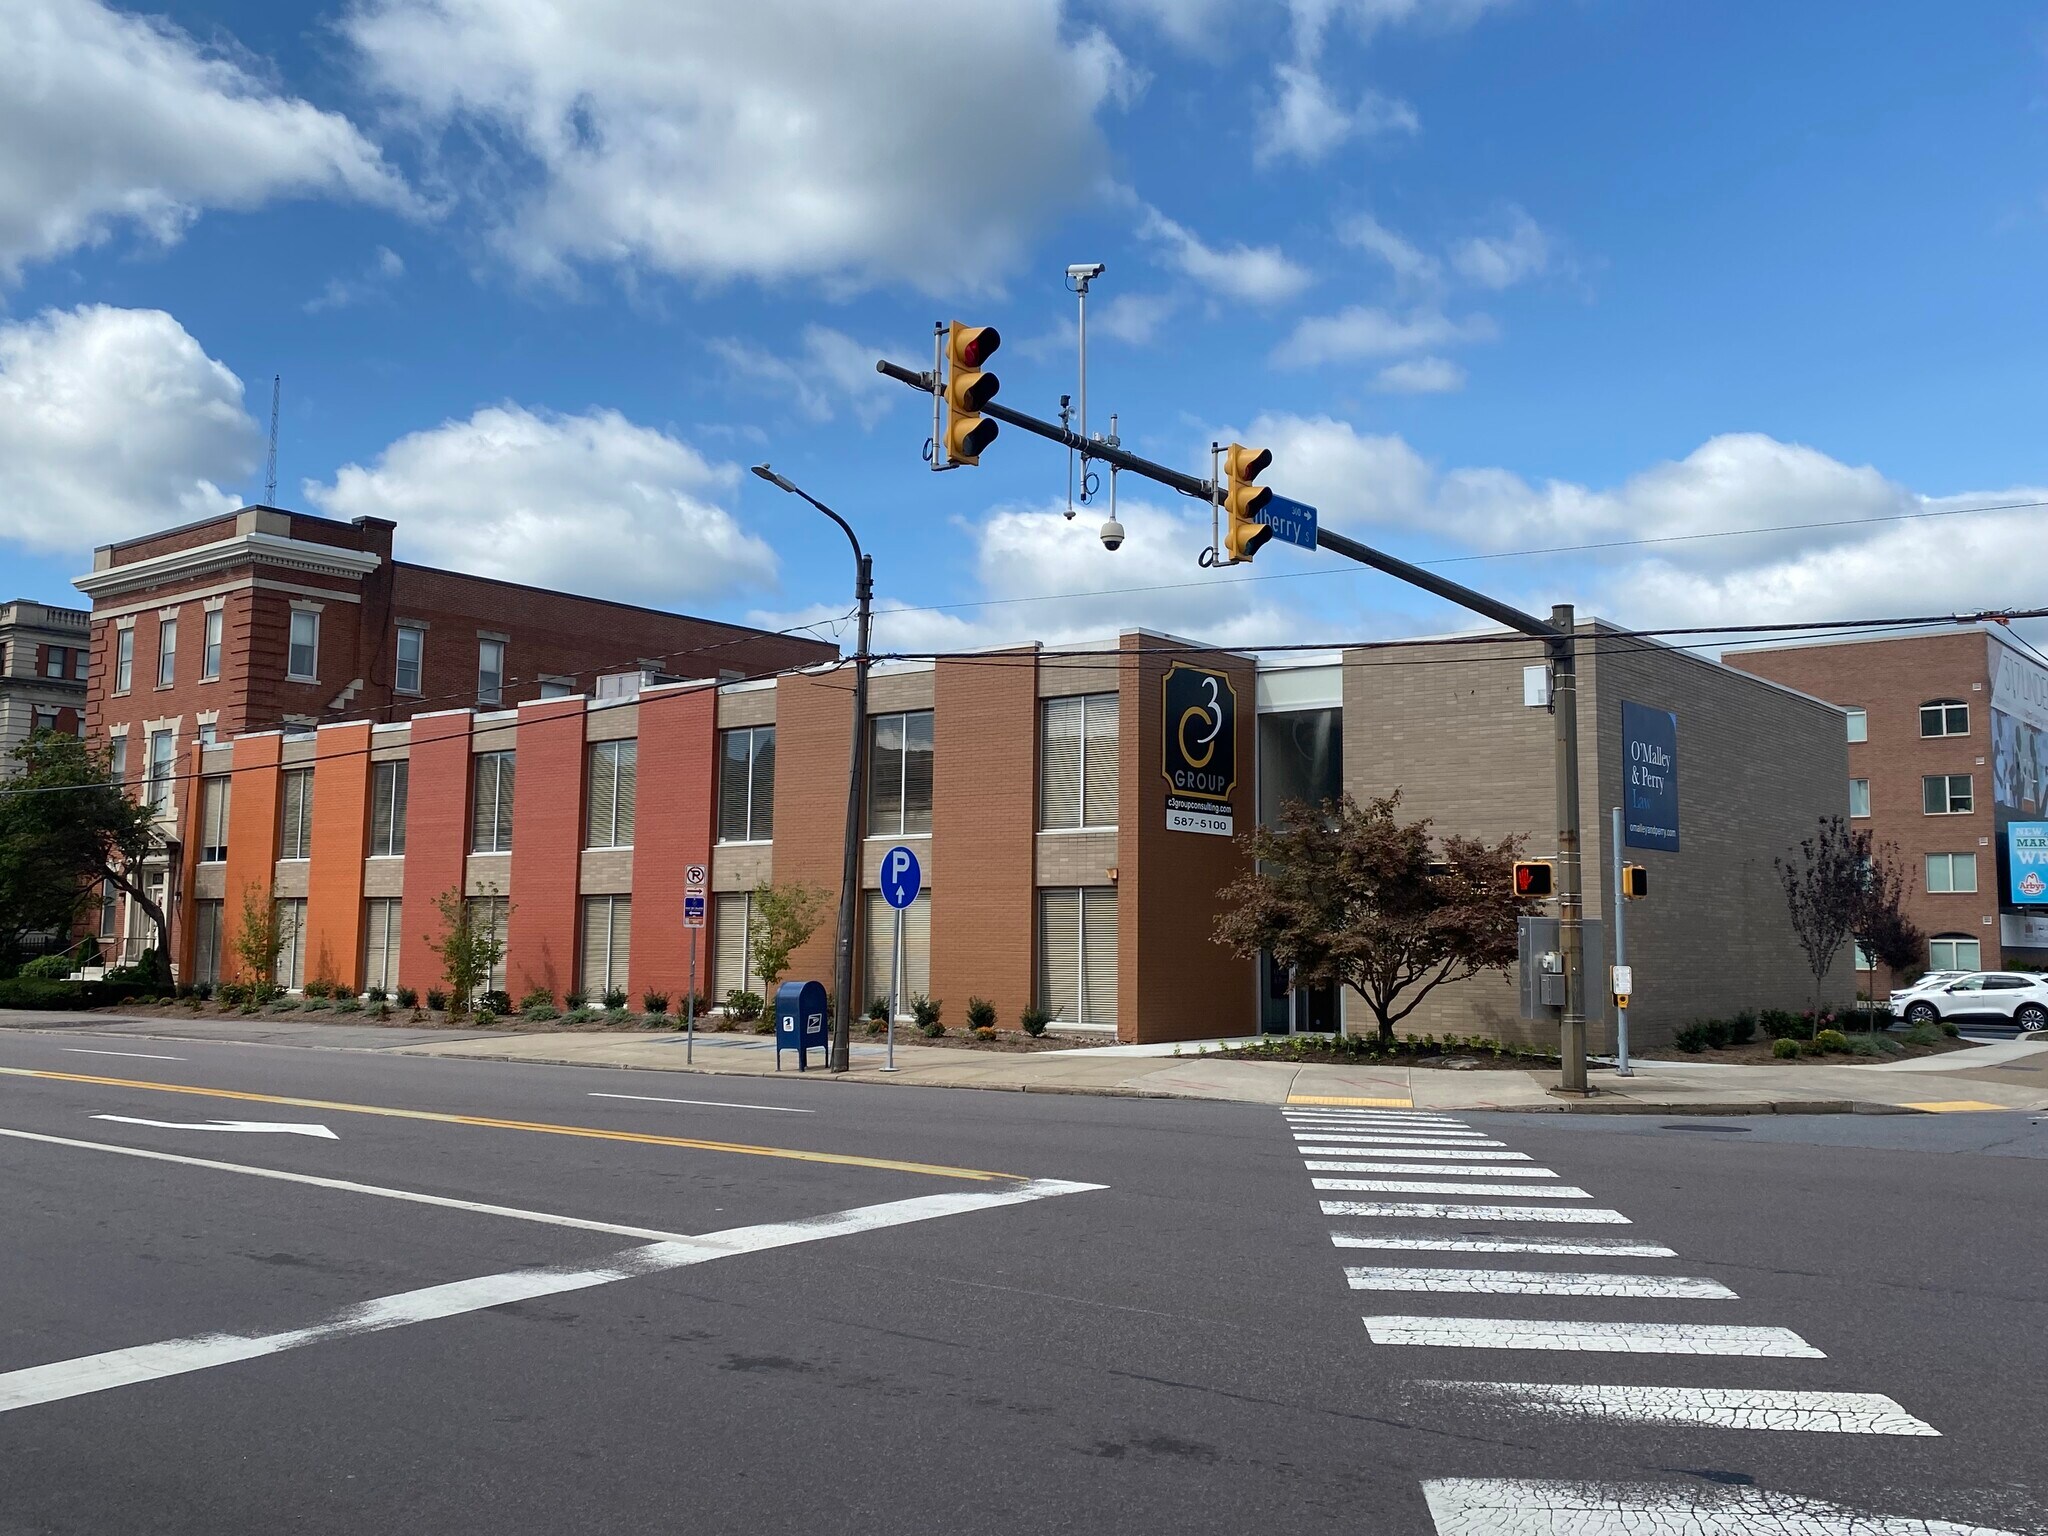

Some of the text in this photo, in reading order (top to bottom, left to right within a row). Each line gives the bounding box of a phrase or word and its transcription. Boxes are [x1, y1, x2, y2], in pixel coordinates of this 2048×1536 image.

[1255, 508, 1302, 544] lberry
[1631, 740, 1671, 773] O'Malley
[1175, 769, 1225, 792] GROUP
[1631, 765, 1665, 795] & Perry
[1168, 798, 1231, 813] c3groupconsulting.com
[1632, 788, 1651, 810] Law
[1174, 816, 1227, 831] 587-5100
[1630, 823, 1676, 838] omalleyandperry.com
[2015, 827, 2043, 837] NEW
[892, 850, 910, 884] P
